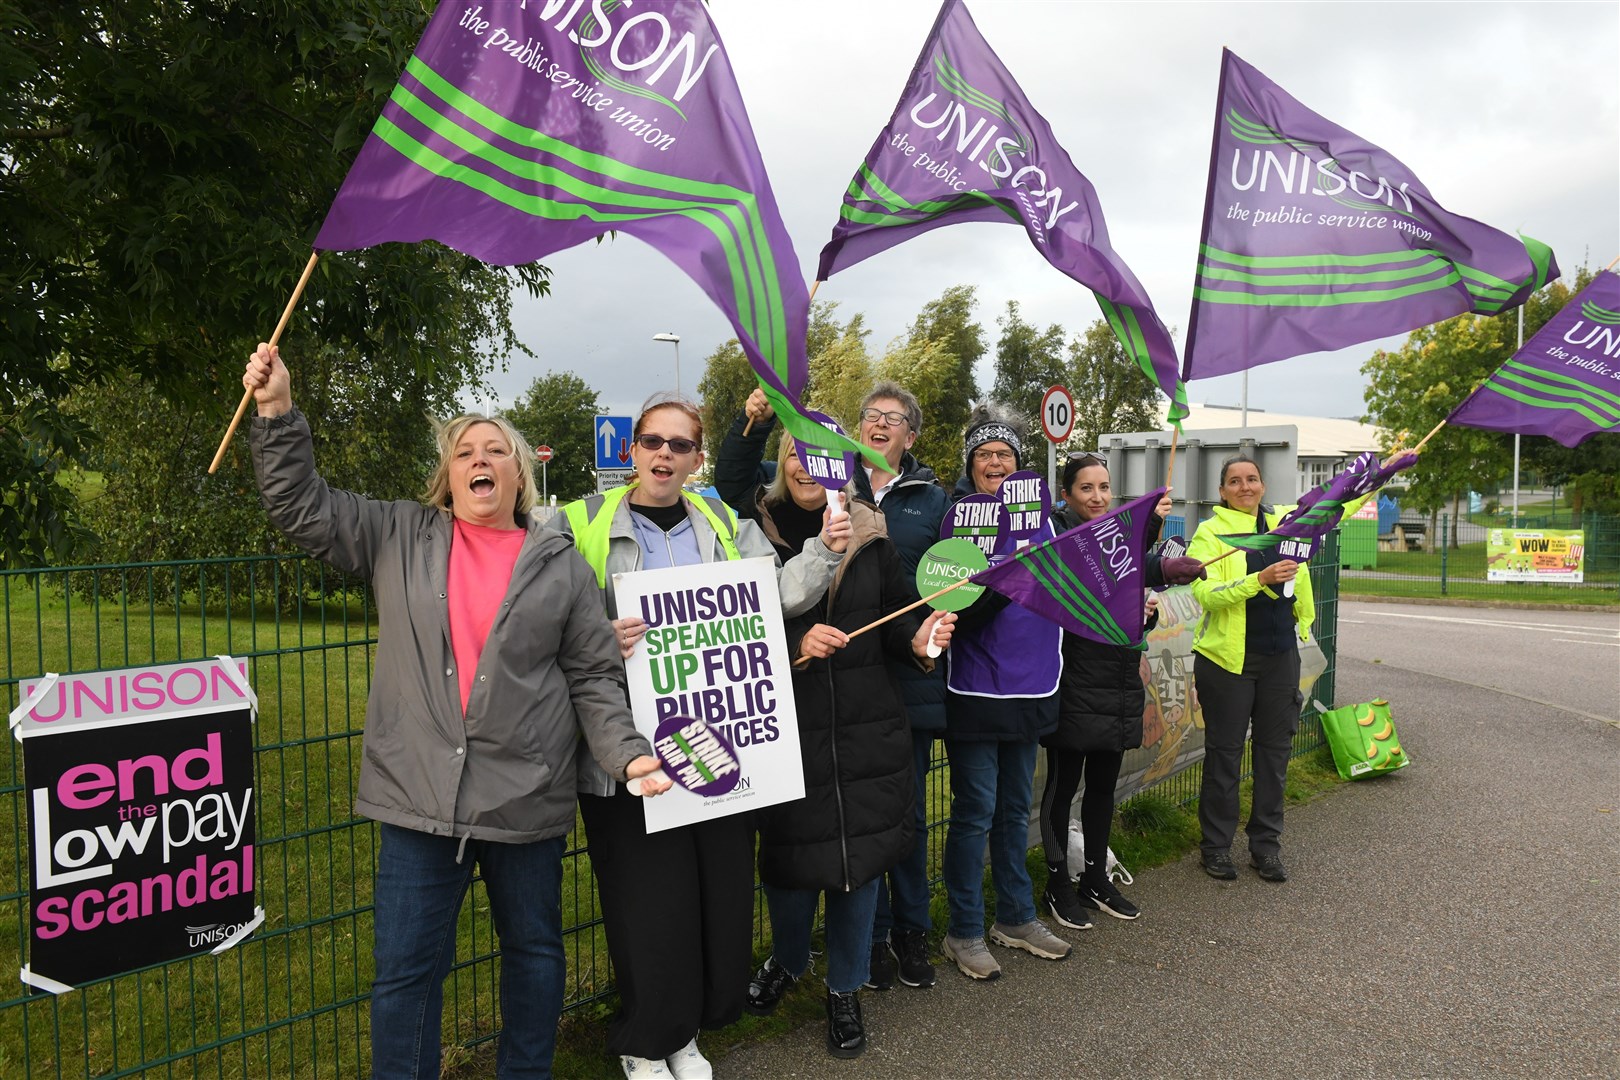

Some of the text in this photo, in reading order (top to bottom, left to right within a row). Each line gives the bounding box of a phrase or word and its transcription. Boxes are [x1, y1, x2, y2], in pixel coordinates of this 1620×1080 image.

[519, 0, 719, 102] ISON
[459, 6, 677, 151] the public service union
[890, 133, 967, 193] the public
[910, 92, 1079, 230] UNISON
[1231, 148, 1413, 213] UNISON
[1016, 190, 1046, 244] union
[1226, 202, 1432, 242] the public service union
[1545, 346, 1570, 360] the
[1565, 355, 1612, 376] public
[1048, 403, 1068, 426] 10
[598, 472, 618, 480] Priority
[806, 455, 847, 480] FAIR PAY
[1003, 478, 1042, 504] STRIKE
[953, 502, 1002, 527] STRIKE
[1025, 510, 1042, 530] PAY
[977, 536, 998, 555] PAY
[1091, 517, 1138, 583] NISON
[1279, 540, 1312, 559] FAIR PAY
[1519, 538, 1550, 553] WOW
[922, 578, 941, 588] Local
[926, 561, 980, 580] UNISON
[1083, 554, 1105, 582] service
[640, 581, 761, 629] UNISON
[645, 614, 766, 656] SPEAKING
[649, 642, 773, 695] UP FOR
[27, 663, 247, 723] UNISON
[655, 679, 777, 727] PUBLIC
[57, 732, 225, 810] end
[655, 735, 708, 791] FAIR PAY
[679, 719, 739, 781] STRIKE
[118, 804, 158, 821] the
[33, 787, 253, 890] Low pay
[36, 845, 255, 940] scandal
[189, 921, 247, 948] UNISON
